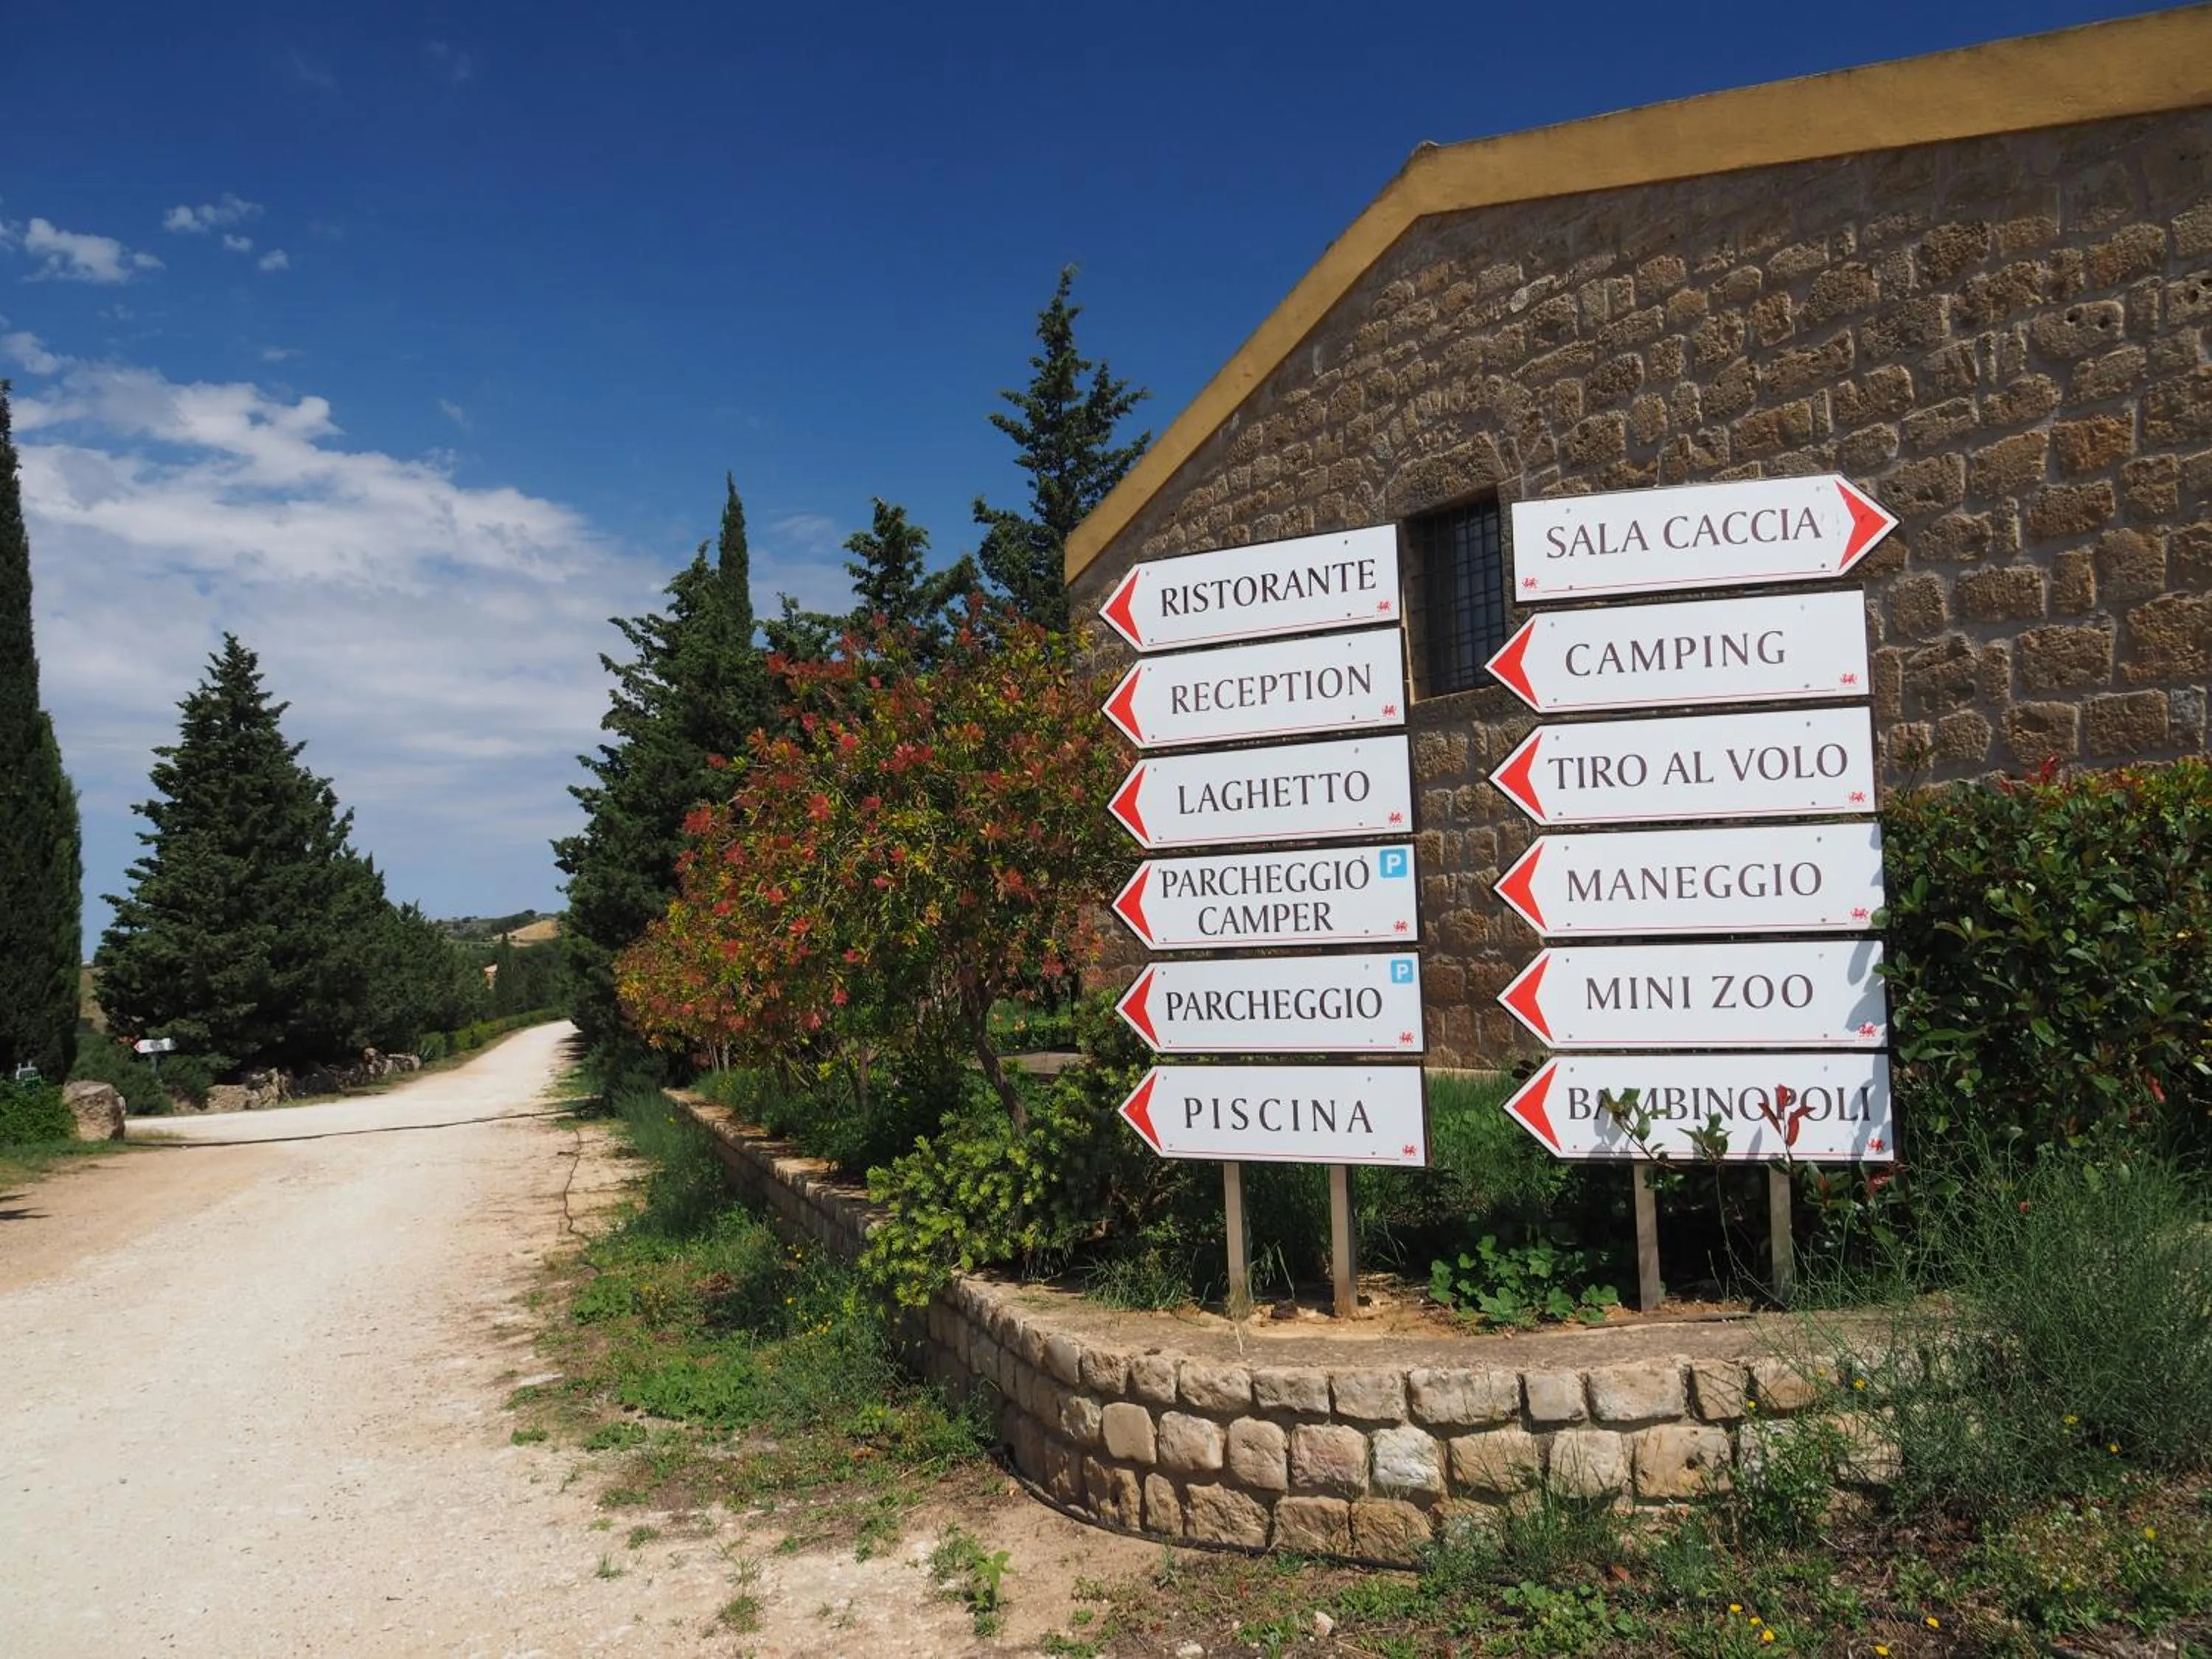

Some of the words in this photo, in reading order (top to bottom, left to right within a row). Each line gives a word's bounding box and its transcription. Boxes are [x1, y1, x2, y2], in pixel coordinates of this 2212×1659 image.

[1546, 521, 1649, 558] SALA
[1663, 507, 1822, 549] CACCIA
[1161, 558, 1377, 617] RISTORANTE
[1565, 630, 1785, 676] CAMPING
[1171, 664, 1371, 714] RECEPTION
[1548, 754, 1647, 790] TIRO
[1663, 751, 1714, 785] AL
[1726, 743, 1848, 782] VOLO
[1178, 771, 1370, 815] LAGHETTO
[1161, 858, 1370, 898] PARCHEGGIO
[1385, 854, 1401, 873] P
[1568, 862, 1822, 902] MANEGGIO
[1198, 902, 1334, 936] CAMPER
[1397, 964, 1410, 980] P
[1586, 976, 1691, 1010] MINI
[1711, 974, 1813, 1009] ZOO
[1166, 987, 1382, 1021] PARCHEGGIO
[1184, 1097, 1374, 1133] PISCINA
